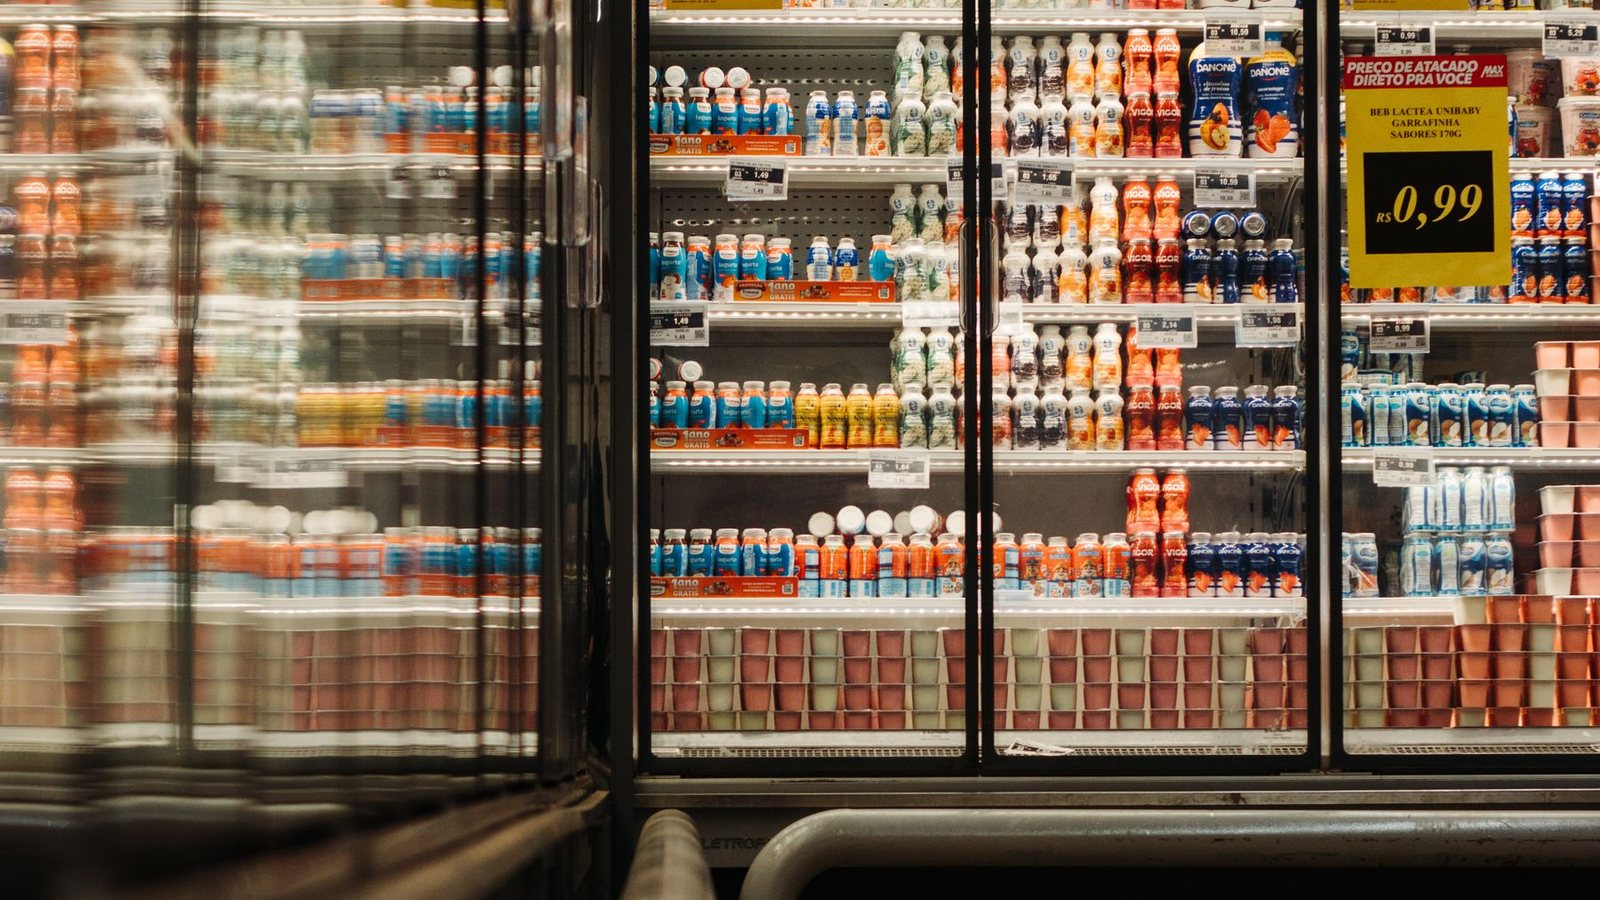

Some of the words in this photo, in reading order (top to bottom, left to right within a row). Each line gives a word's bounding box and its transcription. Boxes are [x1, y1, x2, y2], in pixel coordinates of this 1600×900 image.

[1400, 32, 1416, 40] 0,99
[1567, 29, 1583, 37] 5,29
[1196, 63, 1237, 73] DANONE
[1250, 67, 1290, 77] DANONE
[1346, 61, 1392, 77] PREÇO
[1394, 61, 1414, 73] DE
[1414, 60, 1478, 73] ATACADO
[1481, 65, 1504, 78] MAX
[1353, 74, 1404, 86] DIRETO
[1406, 73, 1433, 85] PRA
[1436, 70, 1474, 85] VOCÊ
[1370, 108, 1390, 116] BEB
[1392, 107, 1433, 116] LACTEA
[1436, 106, 1481, 115] UNIBABY
[1392, 118, 1460, 127] GARRAFINHA
[1390, 130, 1437, 139] SABORES
[1440, 129, 1462, 138] 170G
[754, 171, 769, 179] 1,49
[1219, 178, 1238, 186] 10,59
[1393, 184, 1483, 230] 0,99
[673, 317, 689, 325] 1,49
[1162, 321, 1178, 329] 2,14
[1395, 324, 1410, 333] 0,99
[1398, 461, 1414, 469] 0,99
